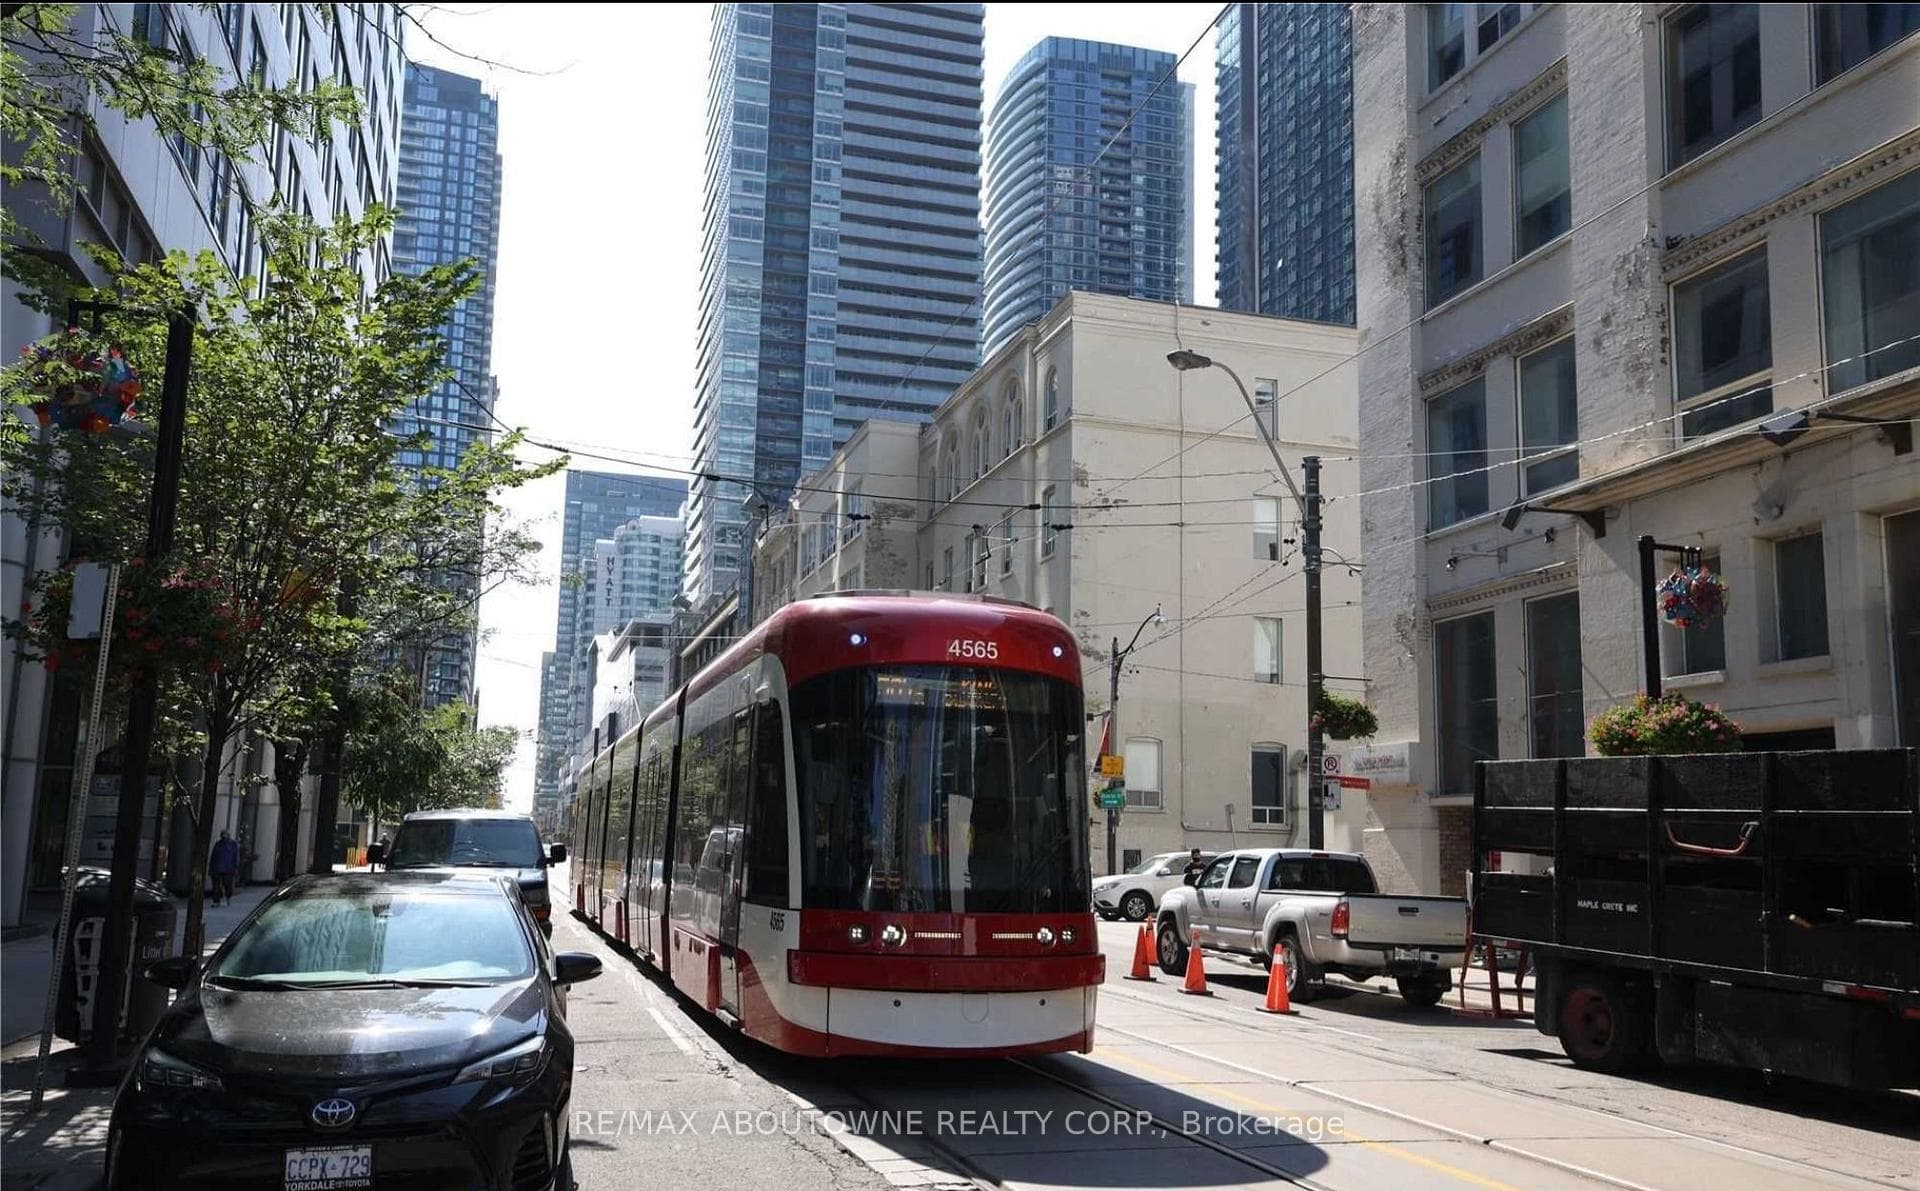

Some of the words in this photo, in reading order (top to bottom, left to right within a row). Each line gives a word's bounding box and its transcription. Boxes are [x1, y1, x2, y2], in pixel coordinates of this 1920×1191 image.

[605, 556, 615, 607] HYATT
[948, 639, 999, 660] 4565
[1577, 900, 1599, 909] MAPLE
[769, 911, 785, 932] 4565
[340, 1155, 370, 1178] 729
[284, 1180, 335, 1191] YORKDALE
